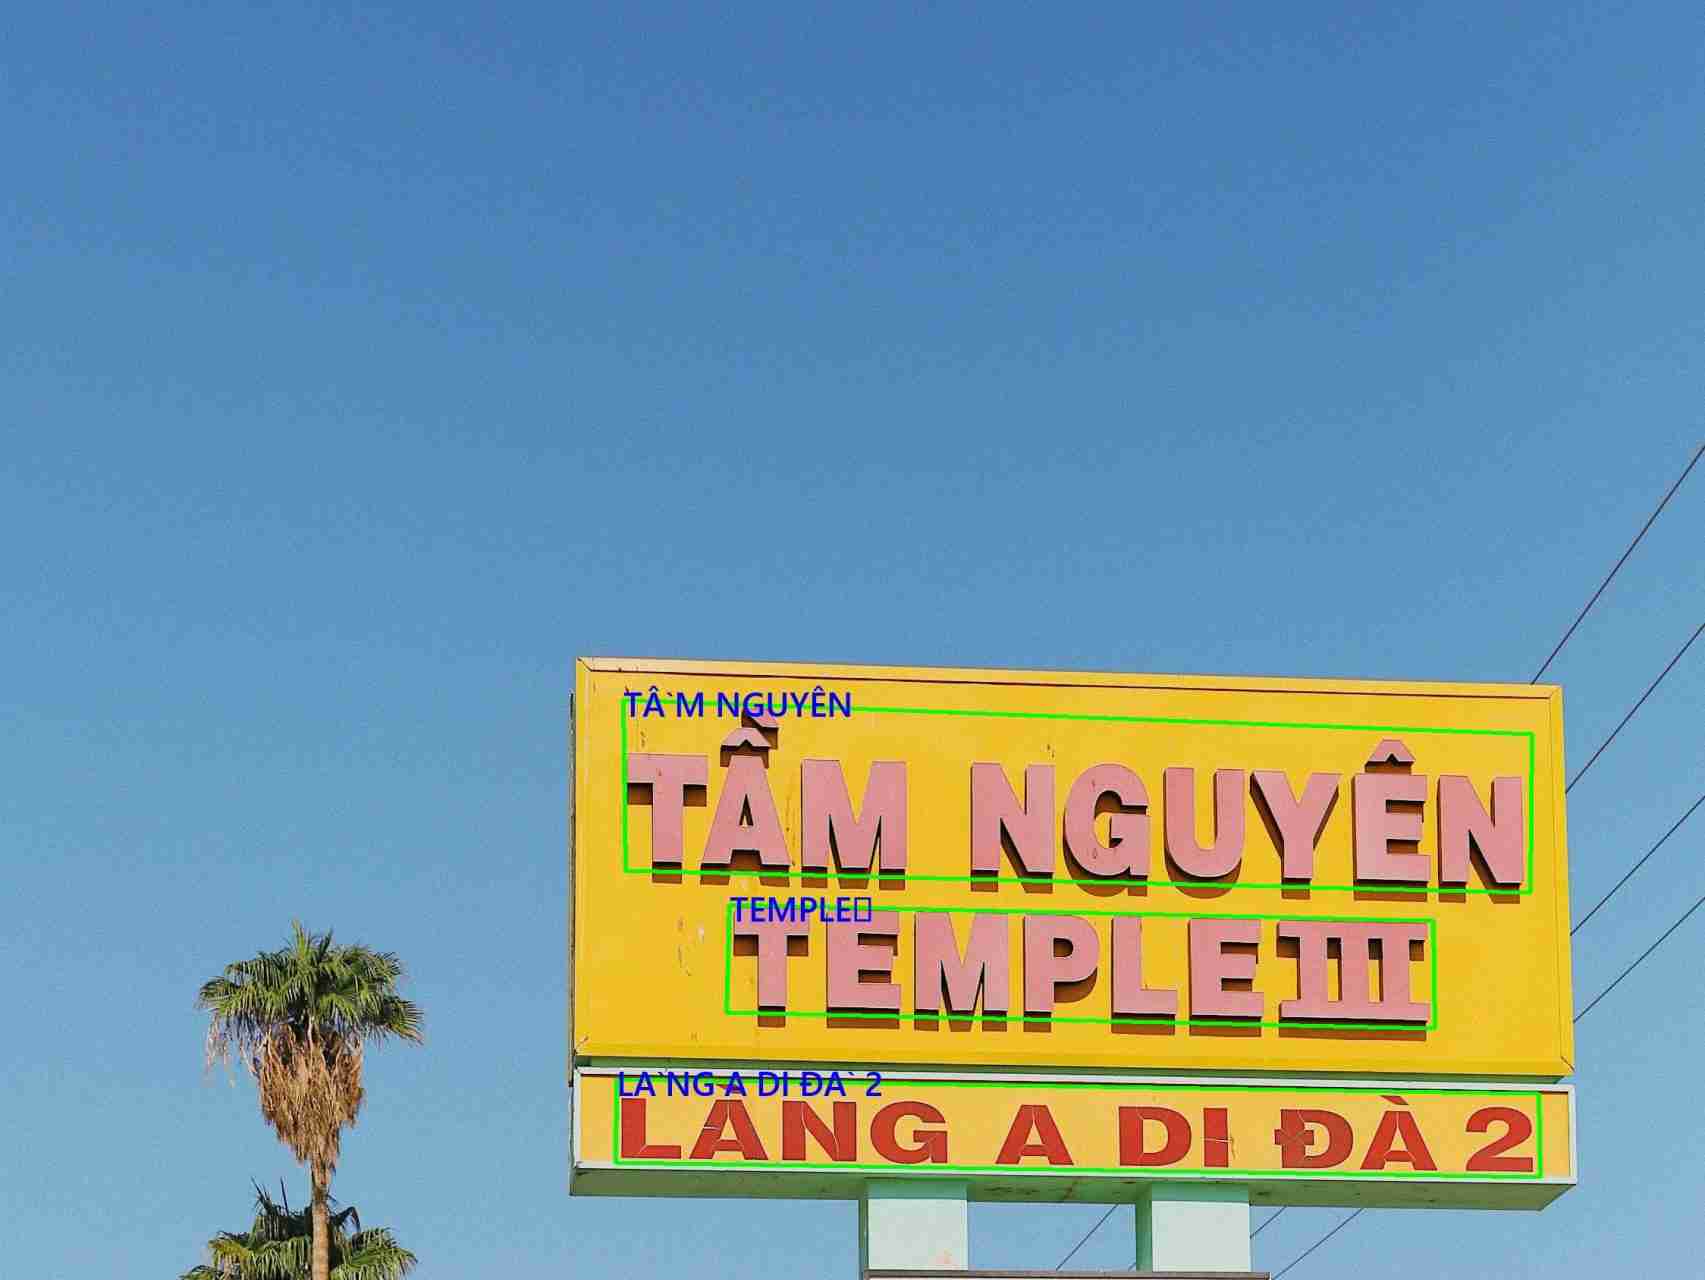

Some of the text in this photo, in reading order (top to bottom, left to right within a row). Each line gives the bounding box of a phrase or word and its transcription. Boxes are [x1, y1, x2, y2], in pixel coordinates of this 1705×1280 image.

[970, 738, 1524, 886] NGUYÊN
[995, 1104, 1075, 1166] A
[1118, 1106, 1230, 1168] DI
[1274, 1095, 1438, 1172] ĐÀ
[1465, 1106, 1535, 1173] 2
